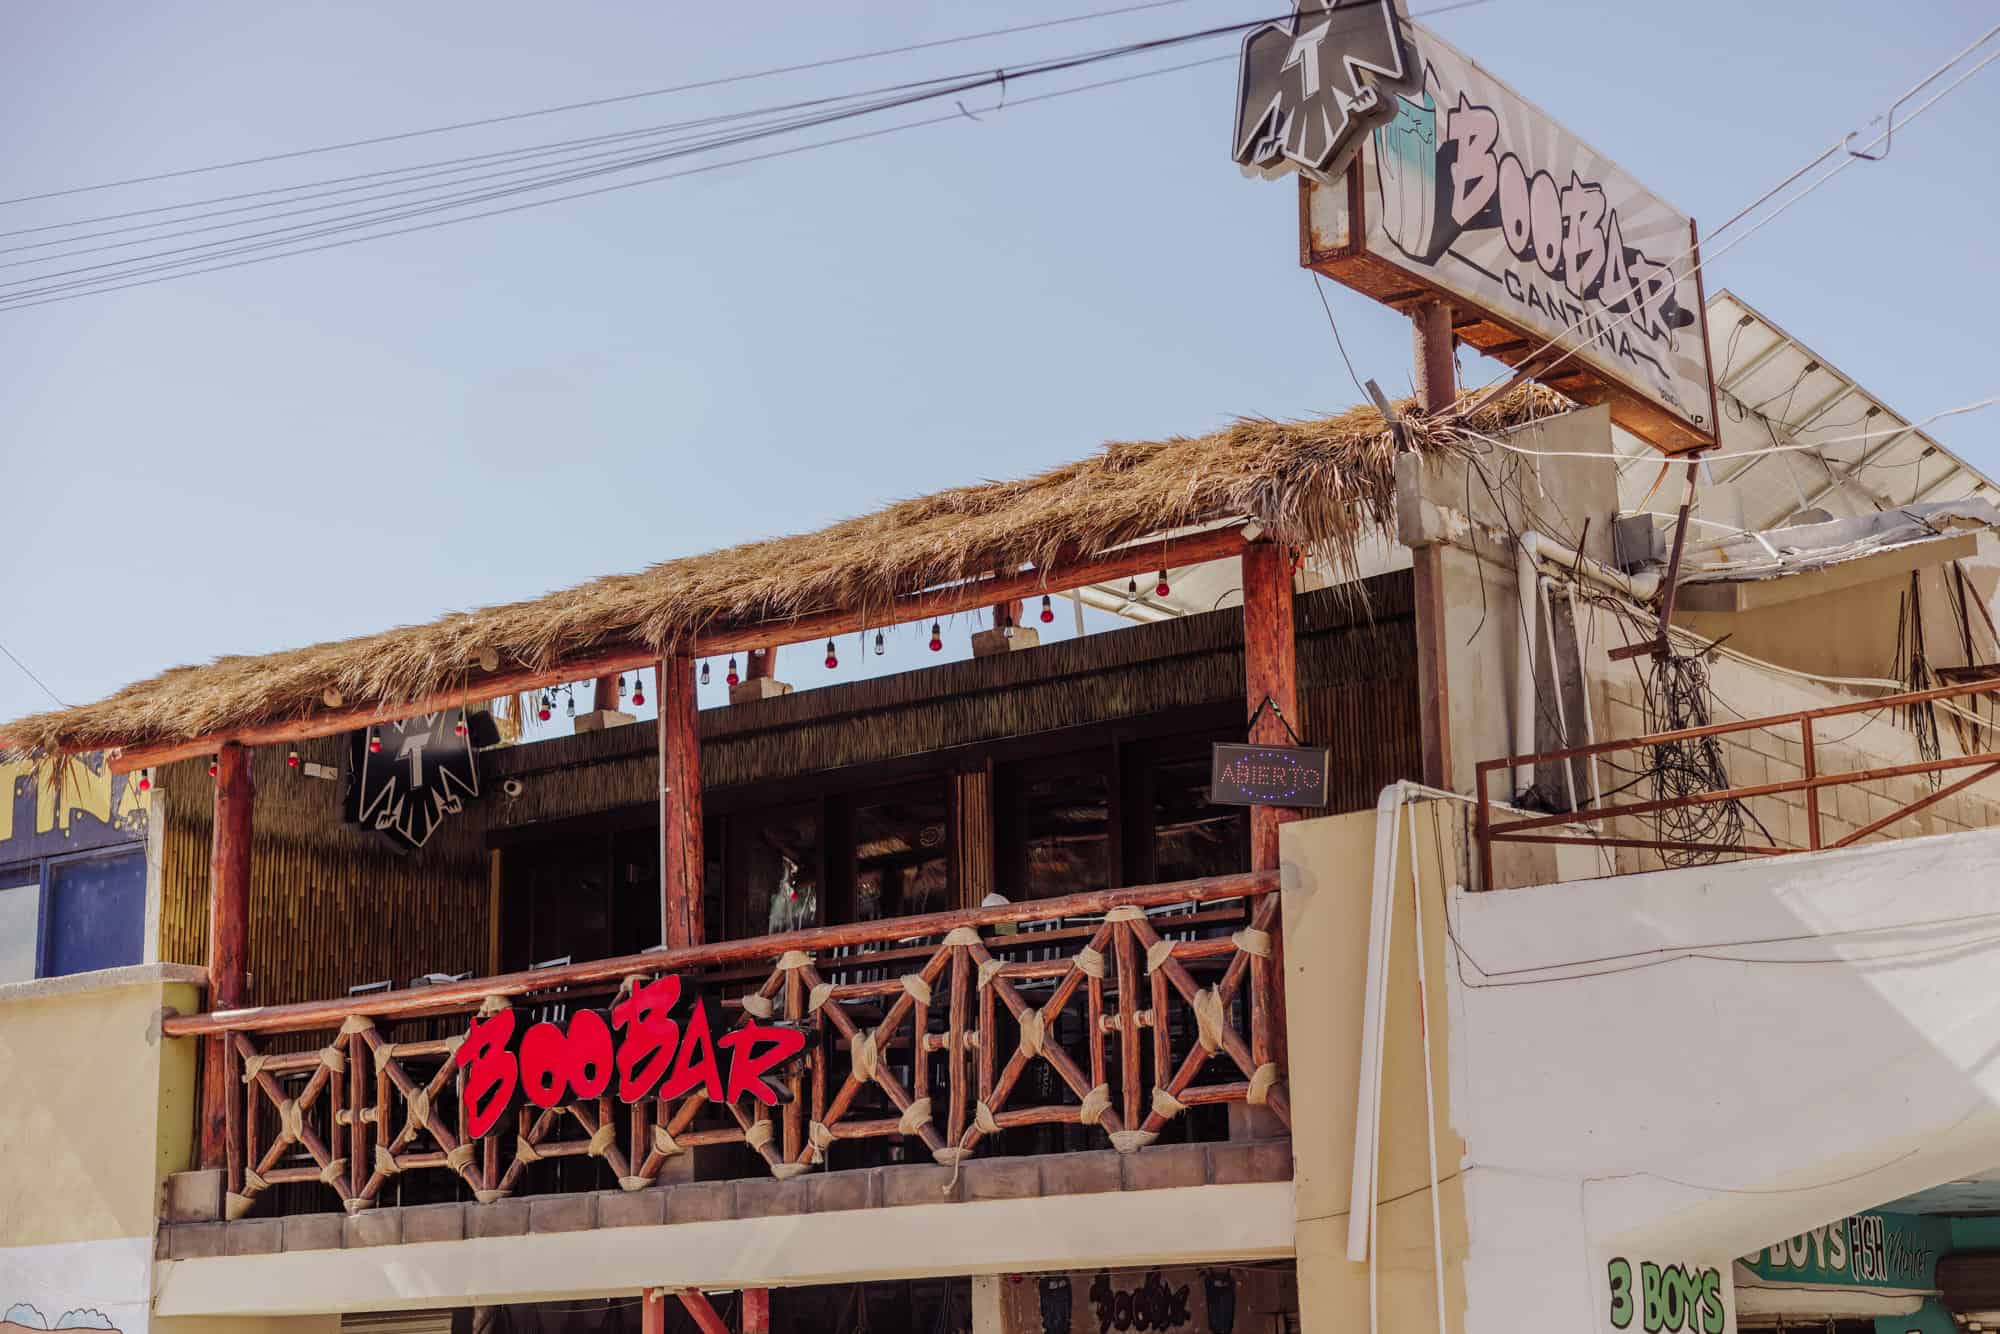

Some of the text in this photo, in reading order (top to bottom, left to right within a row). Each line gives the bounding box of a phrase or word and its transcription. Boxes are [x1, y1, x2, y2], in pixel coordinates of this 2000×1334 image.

[1447, 89, 1677, 346] BOOBAR
[1504, 268, 1637, 364] CANTINA
[1220, 763, 1320, 788] ABIERTO
[455, 974, 805, 1139] BOOBAR
[1849, 1215, 1888, 1281] FISH
[1608, 1257, 1725, 1334] 3 BOYS
